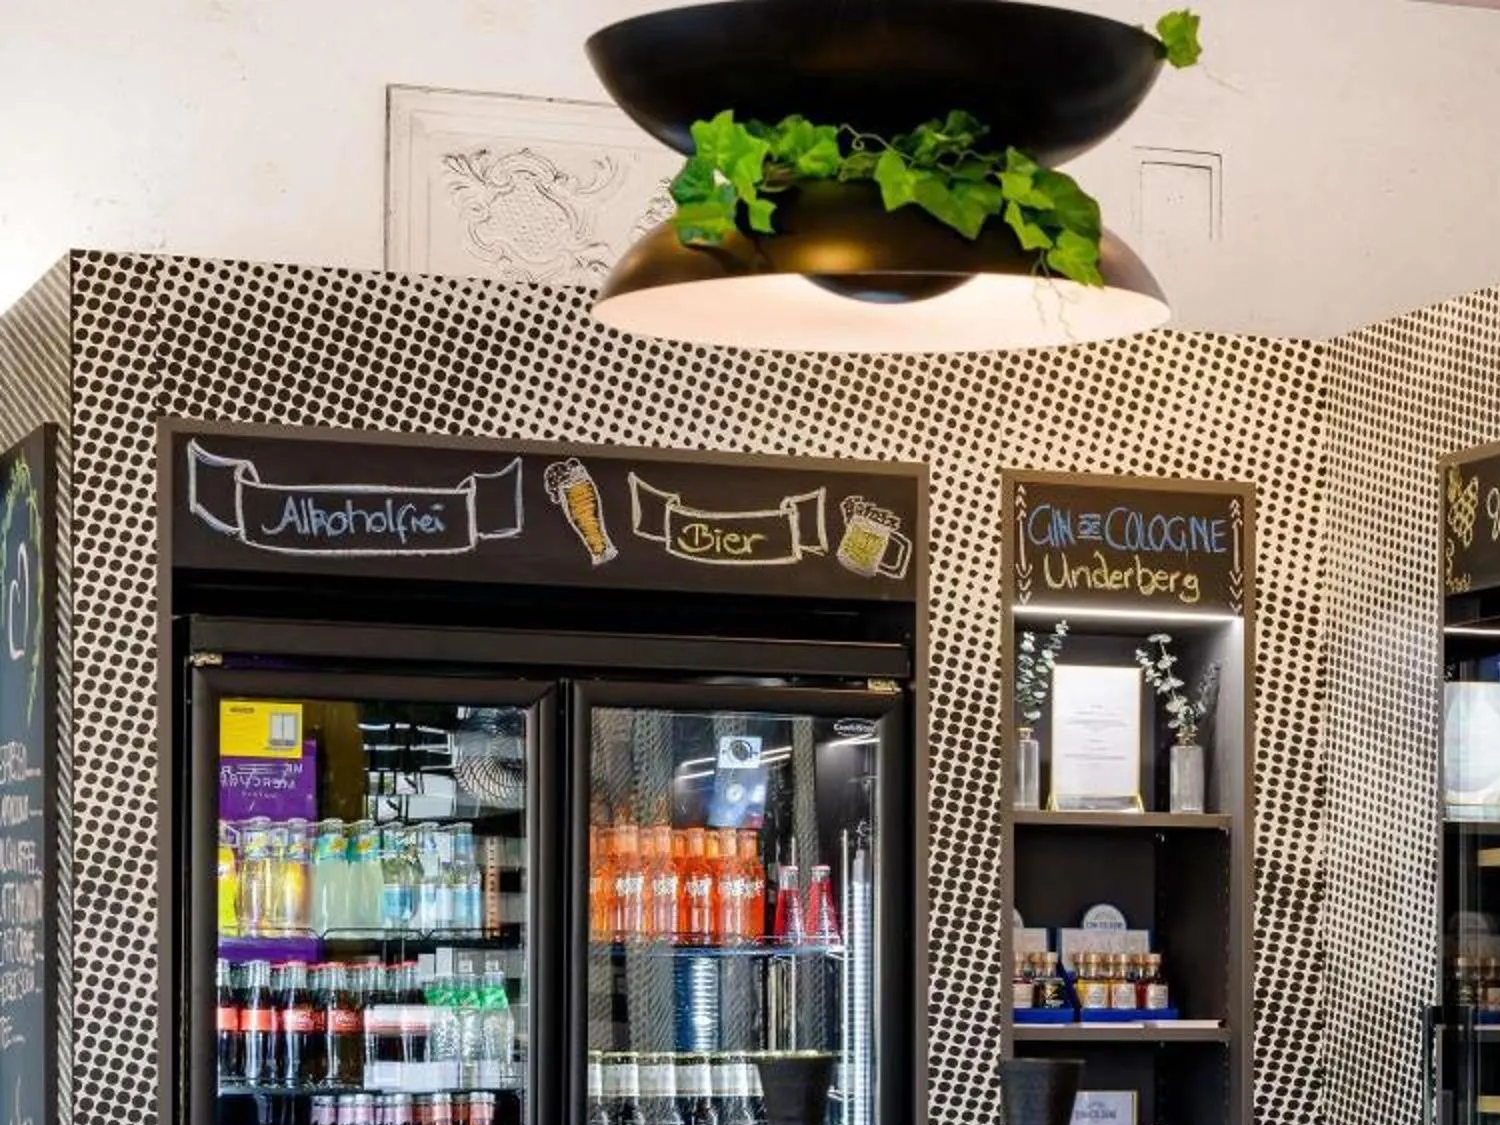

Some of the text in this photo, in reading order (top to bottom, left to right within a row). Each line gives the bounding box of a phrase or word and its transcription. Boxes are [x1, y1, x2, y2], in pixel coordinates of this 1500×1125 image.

[261, 496, 445, 545] Alkoholfrei
[677, 523, 768, 554] Bier
[1105, 507, 1228, 554] COLOGNE
[1043, 551, 1200, 603] Underberg
